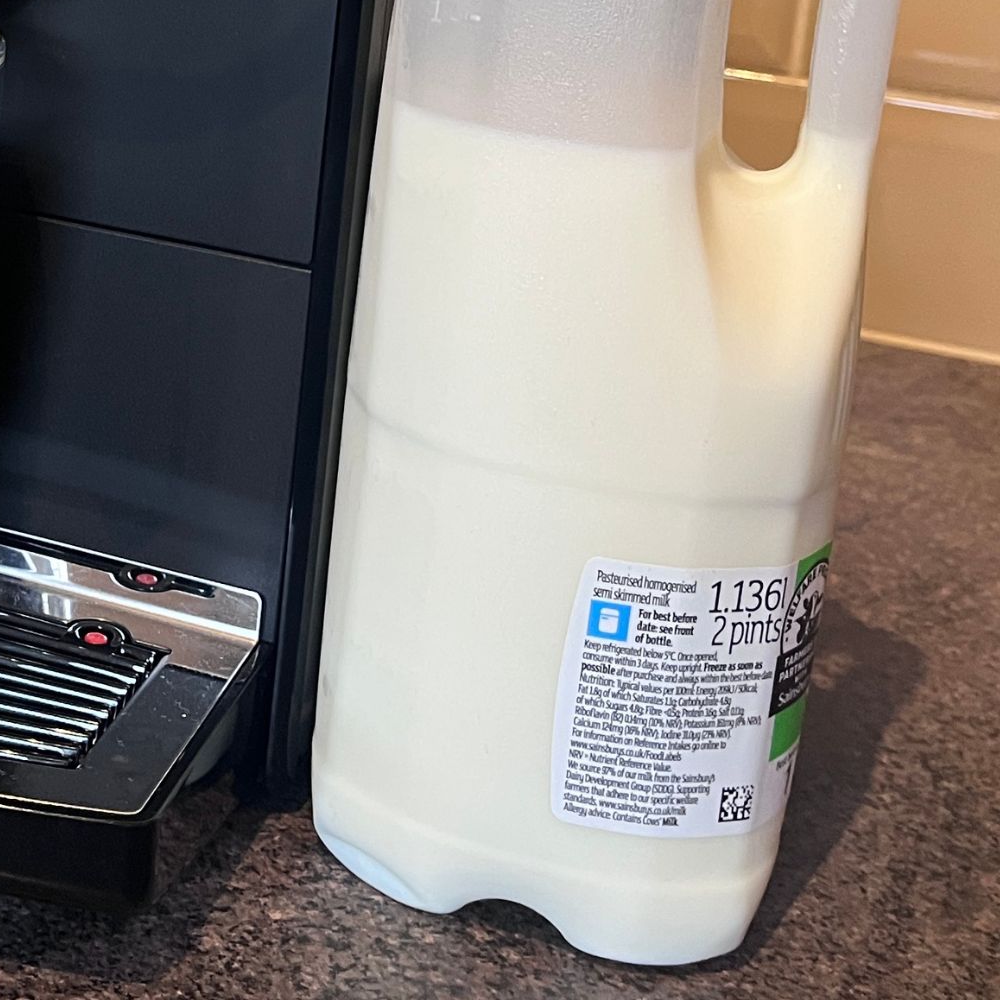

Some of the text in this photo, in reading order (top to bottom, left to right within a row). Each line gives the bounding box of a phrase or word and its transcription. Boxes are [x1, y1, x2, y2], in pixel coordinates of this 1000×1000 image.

[597, 570, 697, 595] Pasteurised homogenised
[593, 586, 670, 607] semi skimmed milk
[638, 609, 698, 624] For best before
[635, 633, 673, 647] of bottle.
[659, 625, 673, 634] see
[674, 624, 695, 636] front
[711, 613, 782, 655] 2 pints
[583, 639, 601, 652] Keep
[602, 643, 642, 656] refrigerated
[643, 648, 663, 659] below
[580, 662, 616, 676] possible
[616, 666, 632, 677] after
[633, 670, 664, 681] purchase
[664, 674, 678, 683] and
[582, 652, 614, 664] consume
[614, 656, 636, 667] within
[661, 662, 678, 674] Keep
[703, 662, 727, 672] Freeze
[728, 663, 736, 671] as
[737, 663, 754, 671] soon
[755, 662, 763, 670] as
[578, 684, 588, 693] Fat
[603, 688, 611, 697] of
[611, 690, 631, 700] which
[632, 693, 663, 705] Saturates
[617, 680, 640, 692] Typical
[641, 683, 662, 694] values
[663, 687, 674, 696] per
[574, 705, 610, 719] Riboflavin
[576, 695, 584, 704] of
[584, 697, 604, 708] which
[606, 700, 628, 711] Sugars
[645, 705, 662, 716] Fibre
[573, 716, 601, 729] Calcium
[572, 727, 583, 737] For
[583, 729, 623, 744] information
[624, 737, 633, 745] on
[634, 737, 667, 750] Reference
[691, 743, 701, 752] go
[720, 741, 726, 749] to
[568, 749, 583, 759] NRV
[589, 753, 618, 765] Nutrient
[619, 757, 652, 770] Reference
[567, 759, 578, 770] We
[579, 763, 601, 774] source
[617, 768, 625, 777] of
[625, 771, 636, 779] our
[637, 771, 653, 782] milk
[653, 773, 670, 783] from
[670, 773, 681, 783] the
[564, 780, 589, 794] farmers
[591, 785, 605, 796] that
[605, 789, 629, 800] adhere
[630, 793, 637, 802] to
[637, 795, 650, 803] our
[566, 770, 584, 783] Dairy
[585, 774, 630, 789] Development
[631, 782, 652, 794] Group
[563, 802, 587, 817] Allergy
[612, 811, 641, 824] Contains
